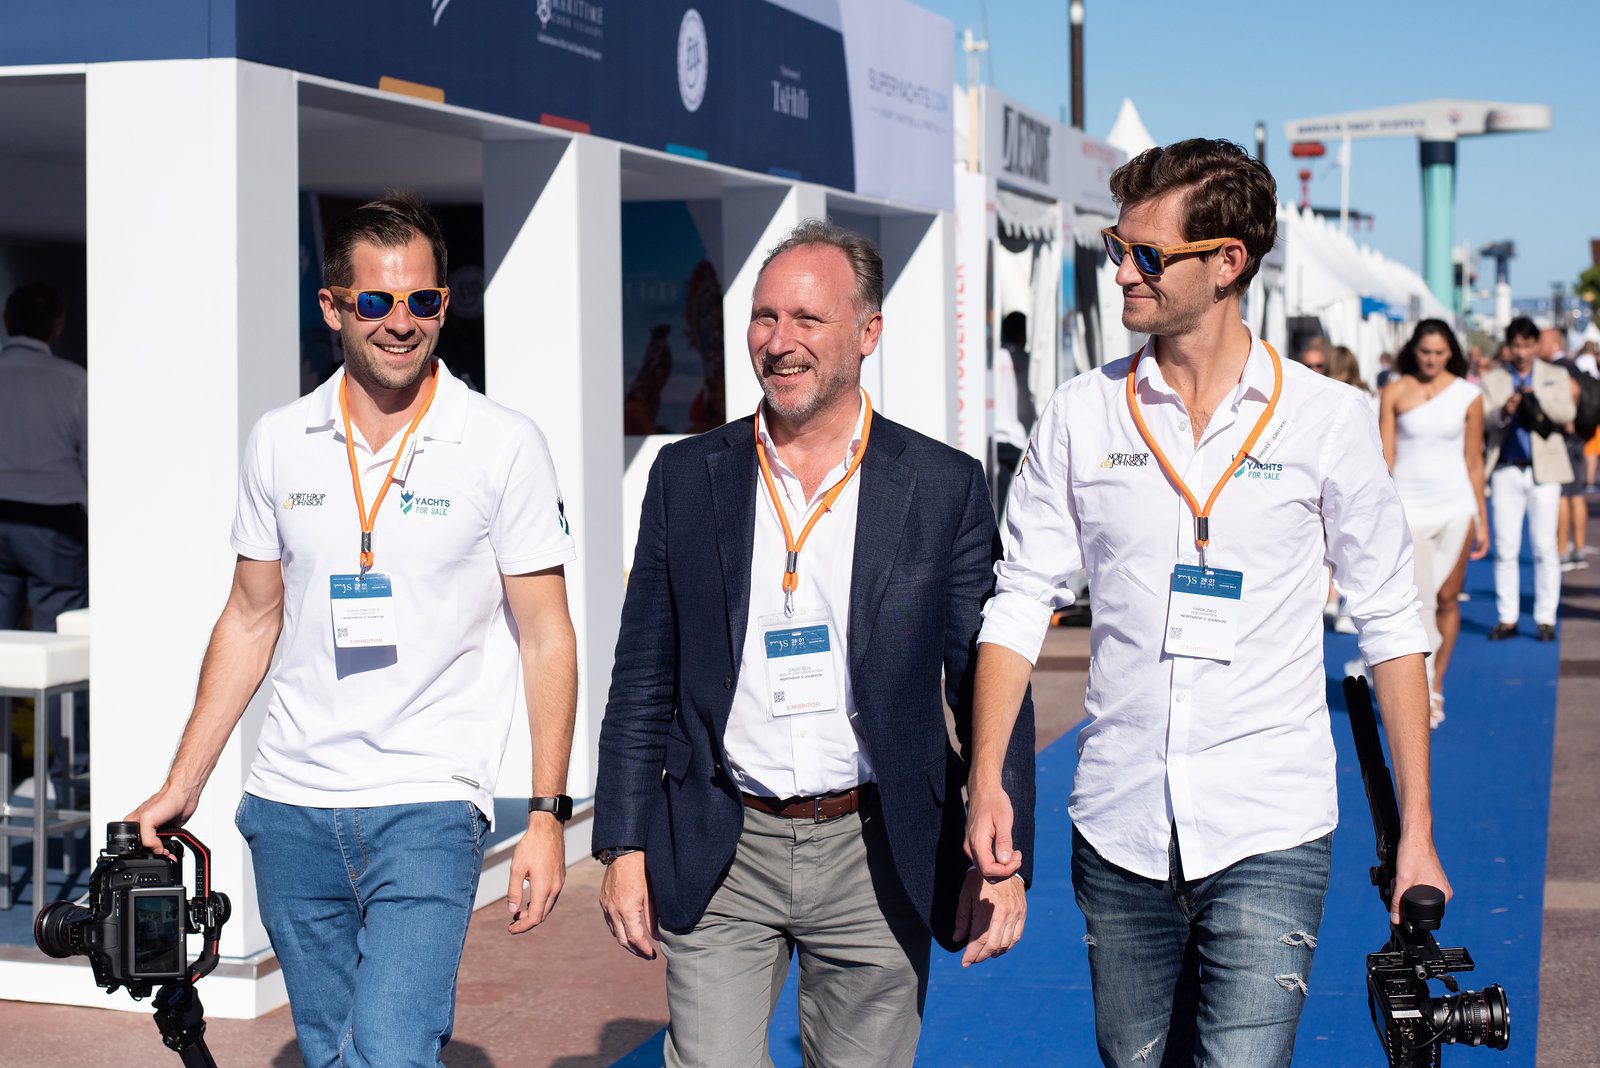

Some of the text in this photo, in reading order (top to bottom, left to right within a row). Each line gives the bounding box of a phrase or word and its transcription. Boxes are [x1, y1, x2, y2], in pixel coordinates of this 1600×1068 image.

[1108, 453, 1150, 461] NORTHROP
[1109, 459, 1147, 468] JOHNSON
[1247, 462, 1283, 471] YACHTS
[1247, 471, 1280, 480] FOR SALE
[288, 493, 326, 501] NORTHROP
[290, 499, 323, 509] JOHNSON
[415, 498, 450, 507] YACHTS
[415, 507, 448, 516] FOR SALE
[786, 701, 822, 711] EXHIBITOR
